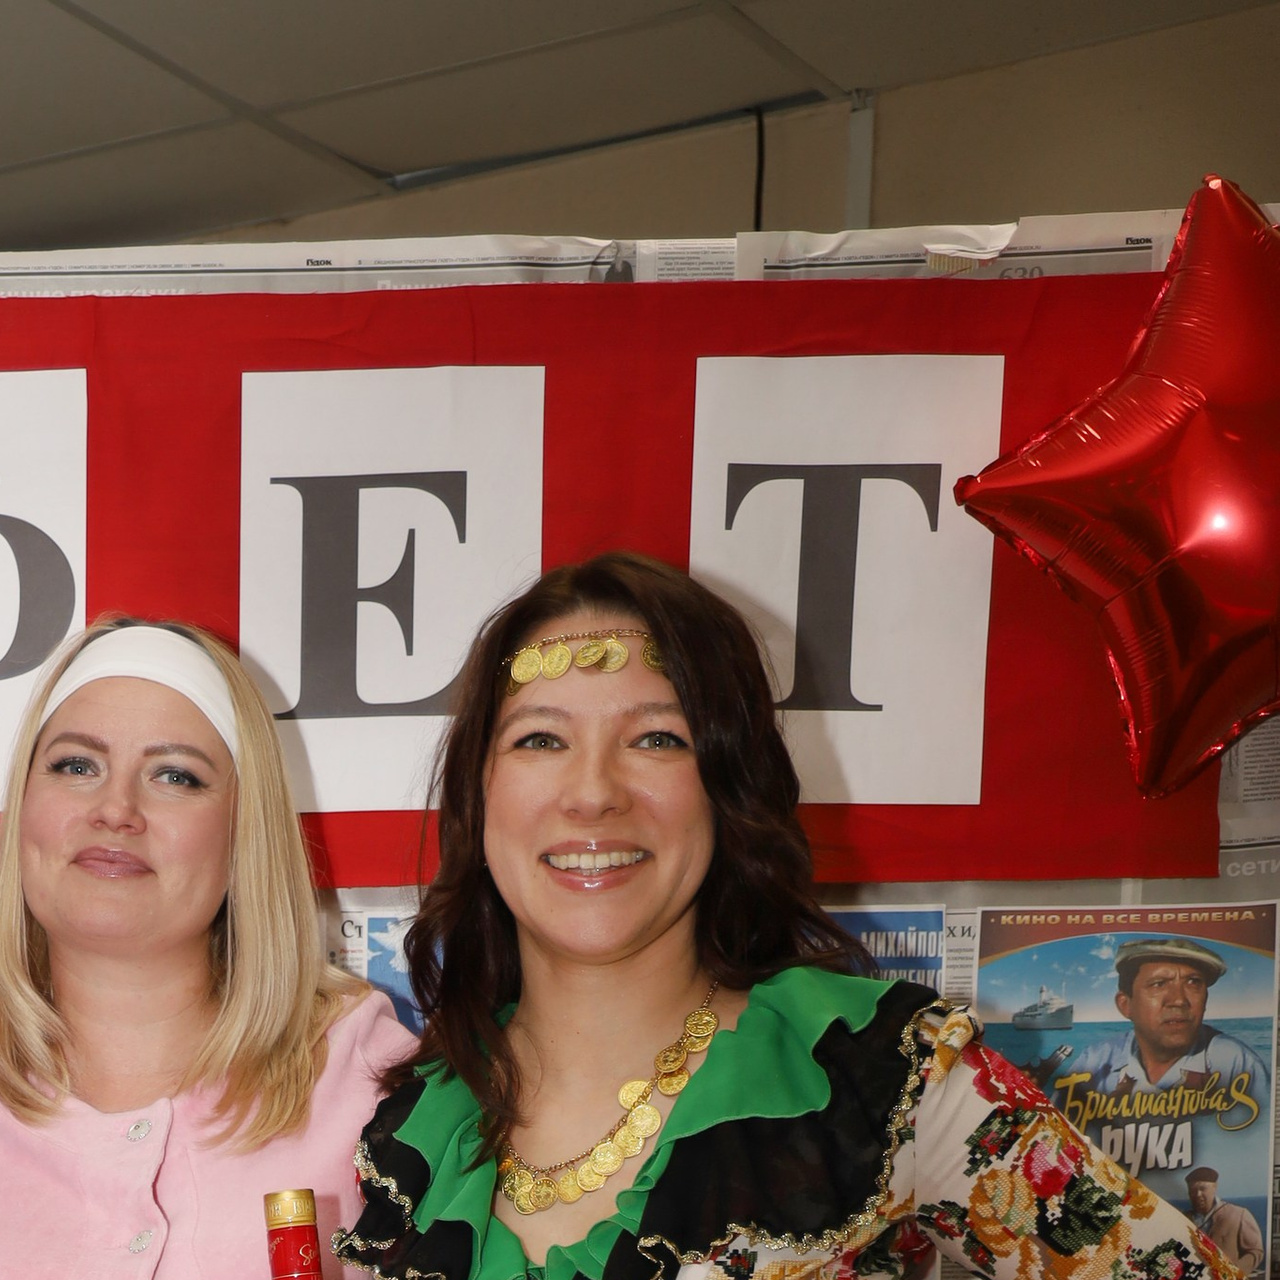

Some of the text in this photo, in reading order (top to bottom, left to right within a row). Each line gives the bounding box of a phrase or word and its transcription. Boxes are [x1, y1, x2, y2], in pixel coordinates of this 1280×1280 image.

[1000, 910, 1256, 926] КИНО НА ВСЕ ВРЕМЕНА
